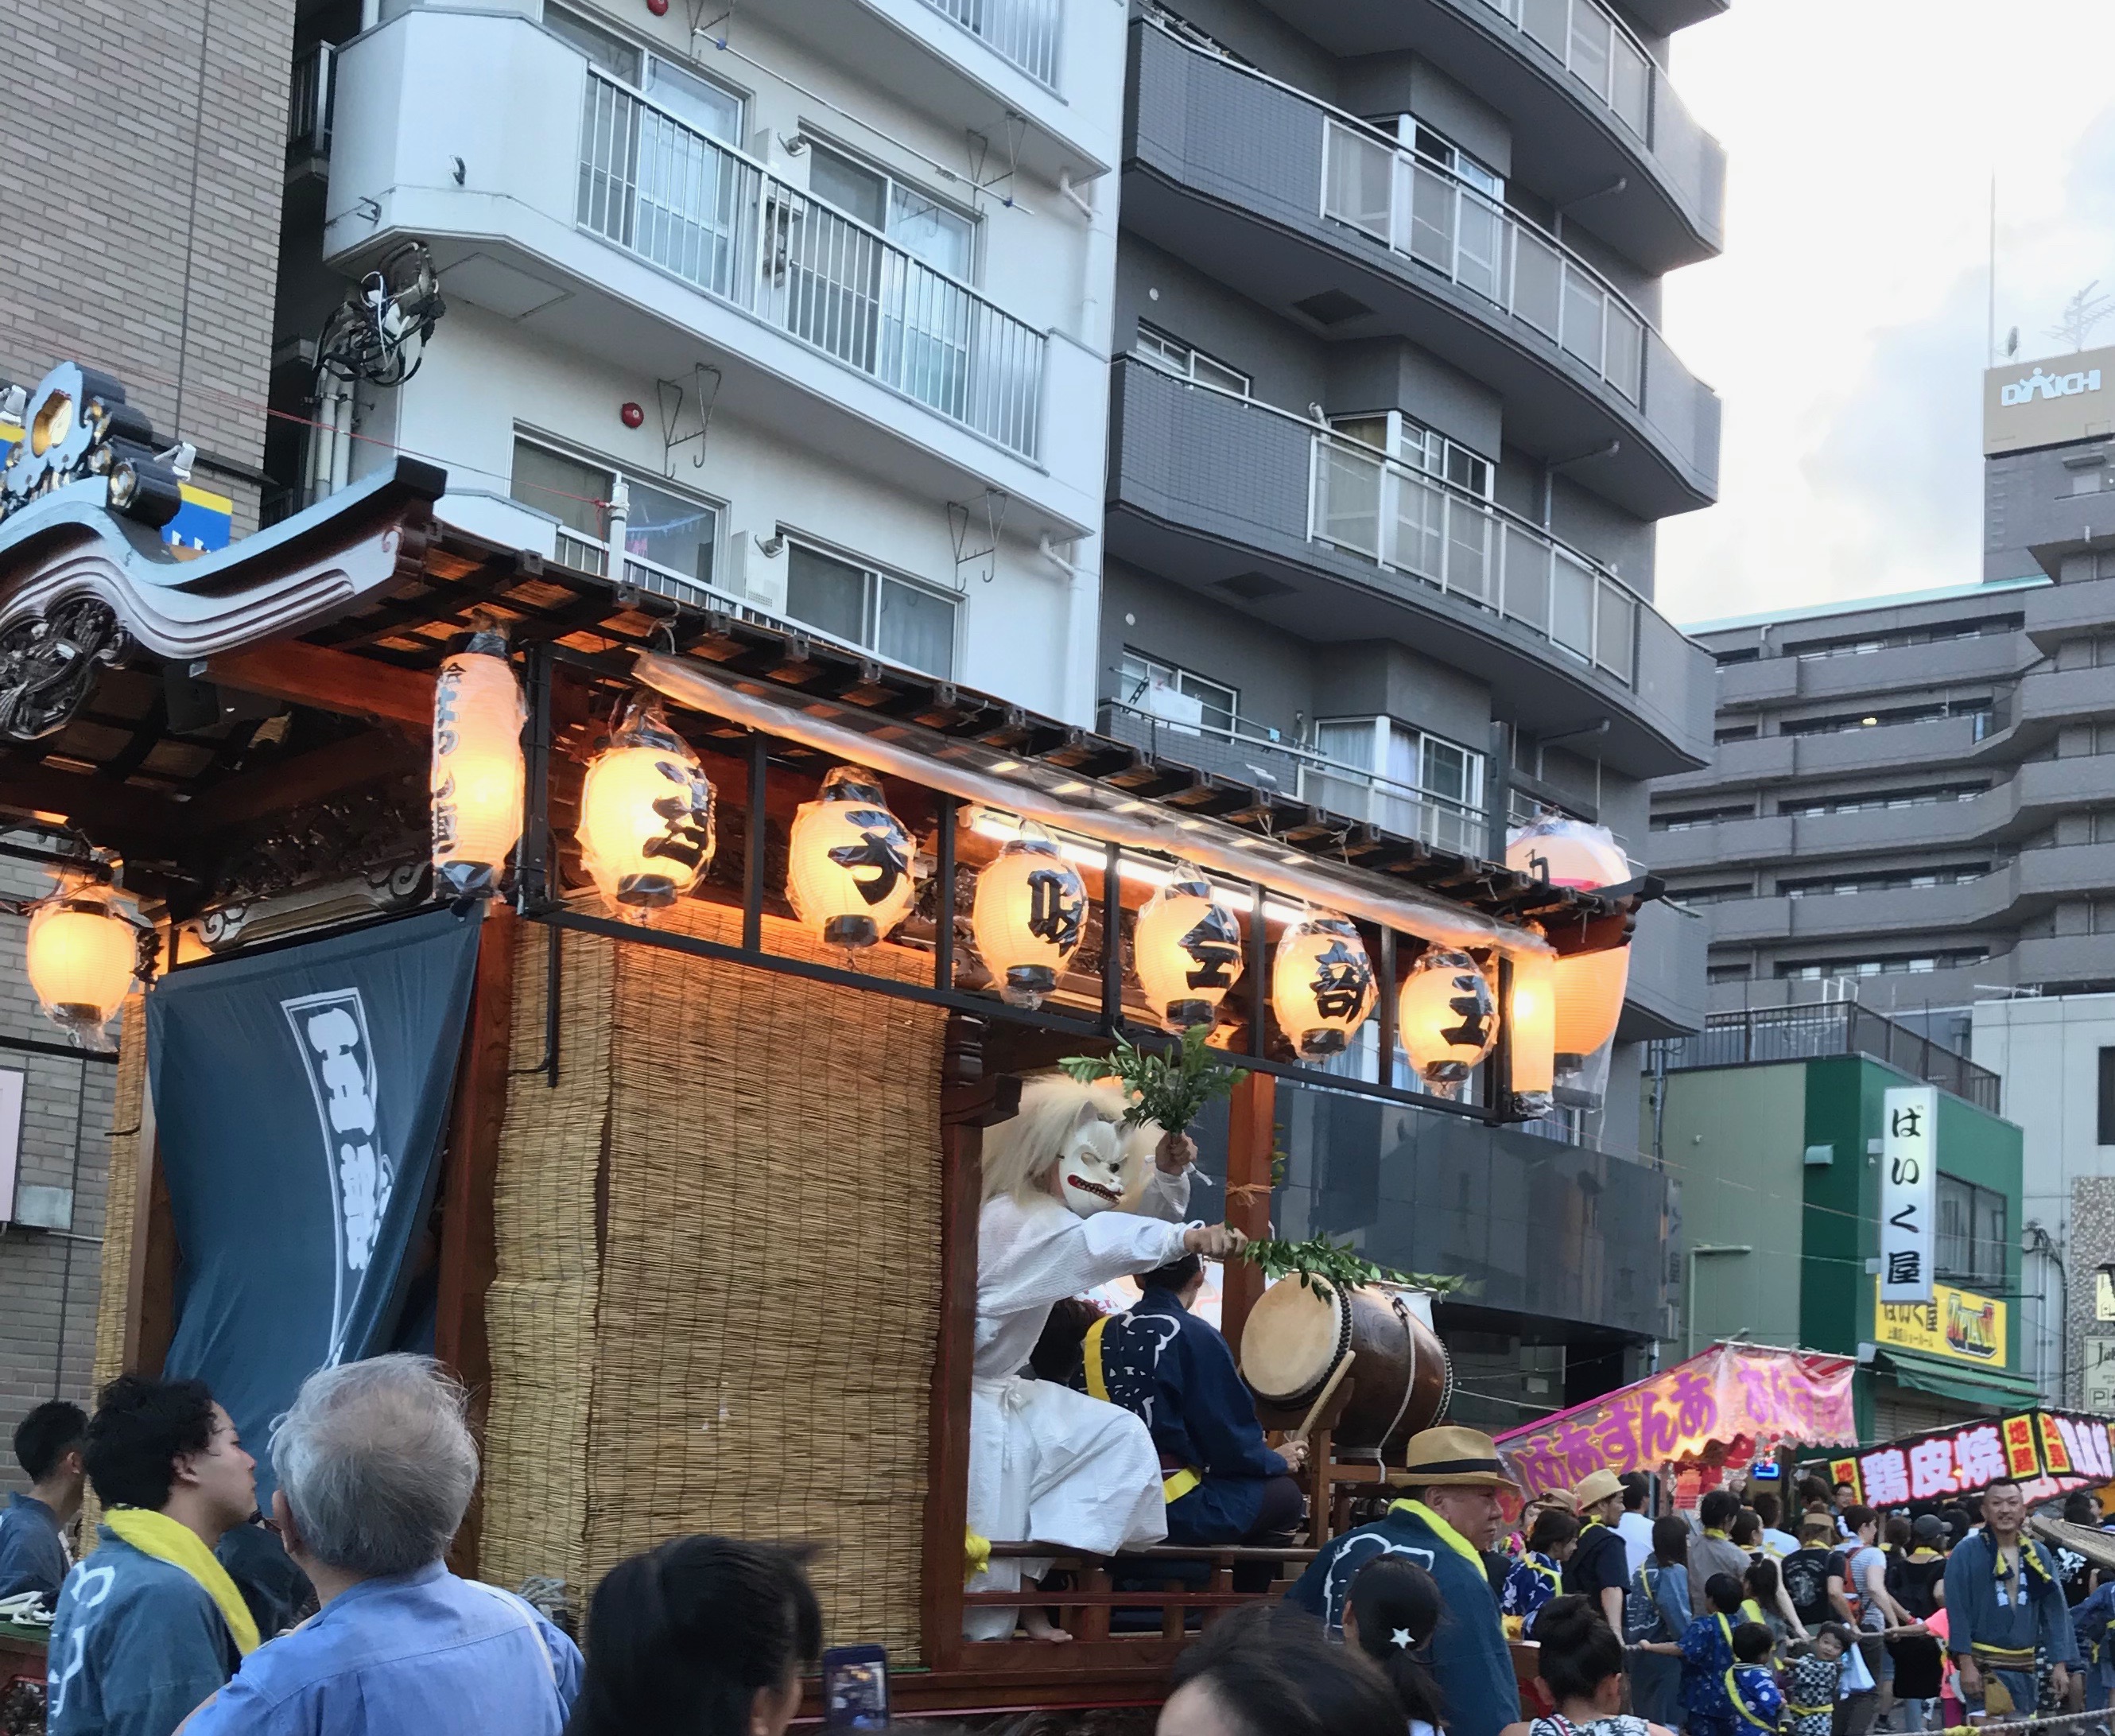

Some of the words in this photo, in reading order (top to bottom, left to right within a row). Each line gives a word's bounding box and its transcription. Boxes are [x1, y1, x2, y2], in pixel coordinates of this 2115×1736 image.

[1887, 1105, 1923, 1284] ばいく屋
[2094, 1390, 2105, 1405] P
[1862, 1427, 2005, 1508] 鶏皮焼
[2007, 1419, 2035, 1474] 地鶏
